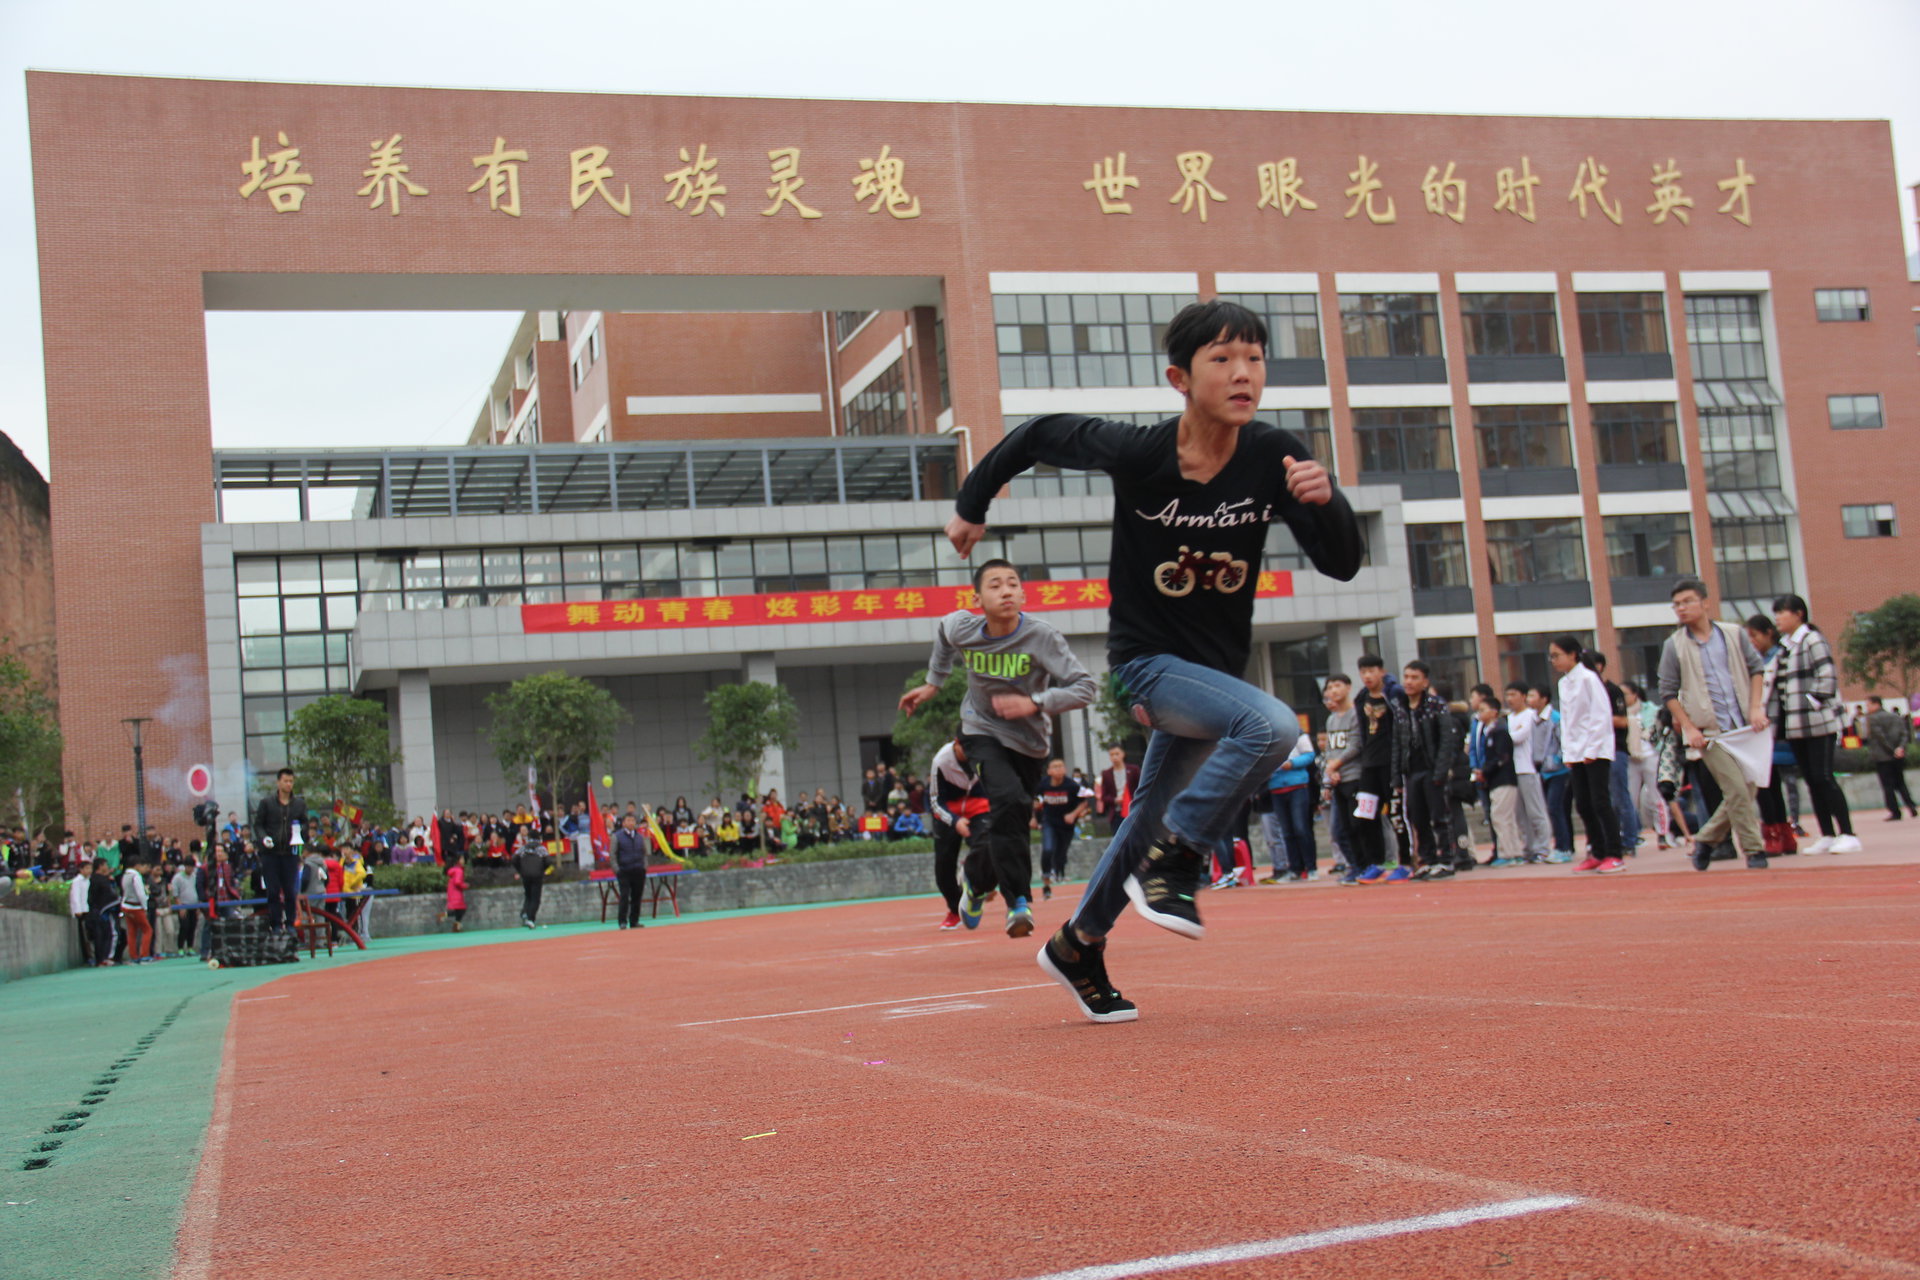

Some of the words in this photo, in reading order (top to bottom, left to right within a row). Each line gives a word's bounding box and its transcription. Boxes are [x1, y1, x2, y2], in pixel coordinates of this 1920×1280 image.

[238, 131, 921, 220] 培养有民族灵魂
[1083, 150, 1757, 227] 世界眼光的时代英才
[1135, 497, 1273, 529] Armani
[566, 598, 735, 626] 舞动青春
[765, 590, 926, 618] 炫彩年华
[962, 649, 1032, 679] YOUNG
